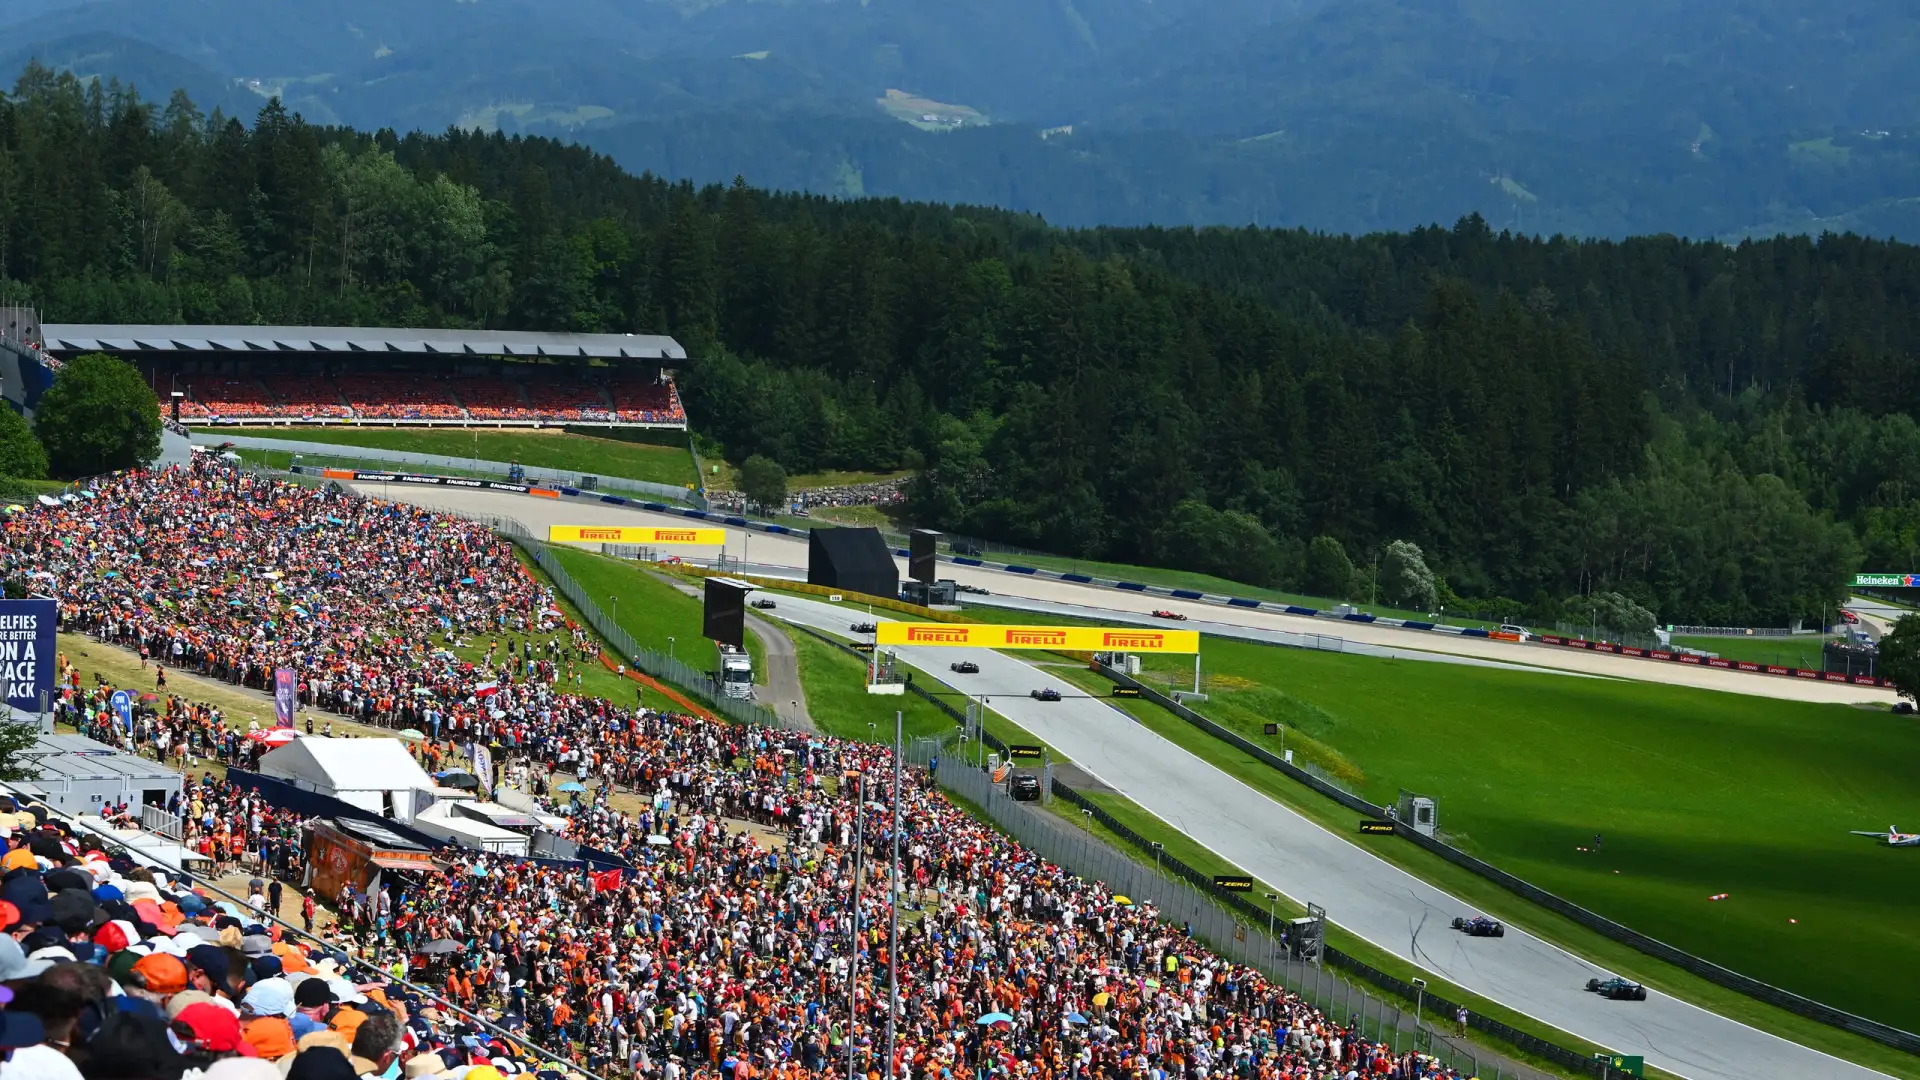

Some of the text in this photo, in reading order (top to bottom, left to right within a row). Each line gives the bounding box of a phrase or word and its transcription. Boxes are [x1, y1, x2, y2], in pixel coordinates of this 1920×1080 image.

[580, 529, 697, 542] PIRELLI PIRELLI
[1856, 575, 1900, 585] Heineken
[0, 615, 37, 630] ELFIES
[10, 631, 36, 640] BETTER
[907, 626, 1164, 648] PIRELLI PIRELLI PIRELLI
[1542, 636, 1560, 644] Lenovo
[1568, 639, 1586, 648] Lenovo
[1595, 643, 1613, 652] Lenovo
[23, 641, 36, 661] A
[1622, 648, 1641, 656] Lenovo
[1651, 652, 1670, 660] Lenovo
[1680, 655, 1699, 664] Lenovo
[1709, 659, 1729, 667] Lenovo
[1738, 663, 1758, 671] Lenovo
[0, 661, 36, 681] ACE
[1768, 666, 1787, 675] Lenovo
[1797, 670, 1816, 678] Lenovo
[1826, 673, 1846, 682] Lenovo
[1855, 677, 1874, 685] Lenovo
[8, 682, 35, 698] ACK
